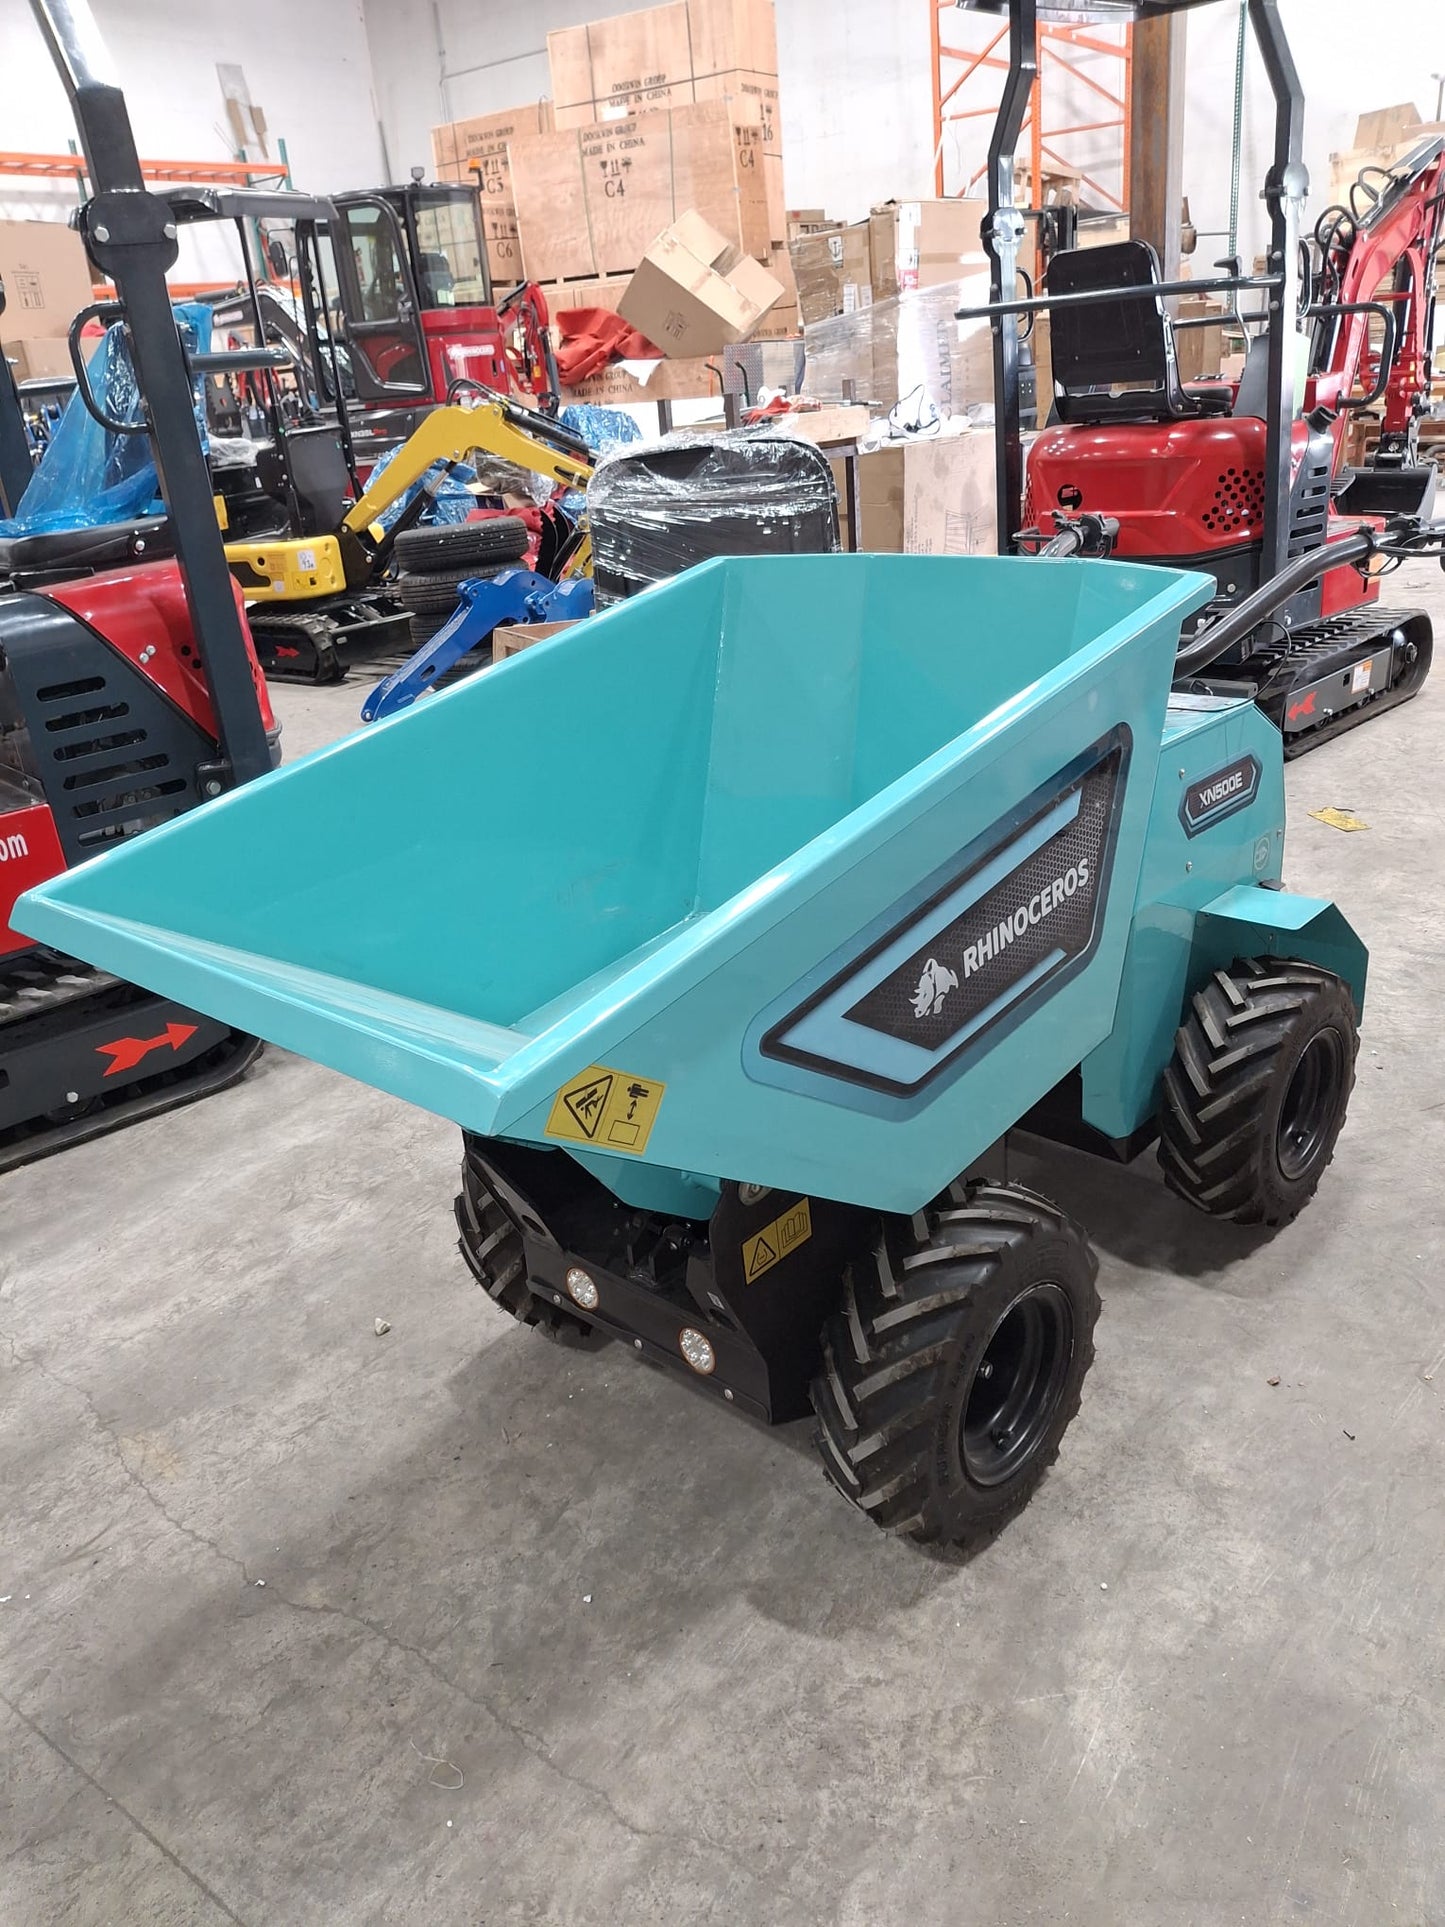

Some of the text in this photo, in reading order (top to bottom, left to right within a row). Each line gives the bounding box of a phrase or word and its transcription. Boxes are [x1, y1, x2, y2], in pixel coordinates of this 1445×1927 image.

[634, 94, 642, 104] IN
[646, 88, 672, 101] CHINA
[606, 143, 615, 153] IN
[619, 137, 646, 150] CHINA
[740, 149, 754, 168] C4
[486, 177, 504, 194] C5
[604, 179, 625, 198] C4
[496, 242, 513, 258] C6
[596, 386, 604, 394] IN
[608, 384, 633, 394] CHINA
[1199, 771, 1243, 809] XN500E
[963, 858, 1089, 978] RHINOCEROS
